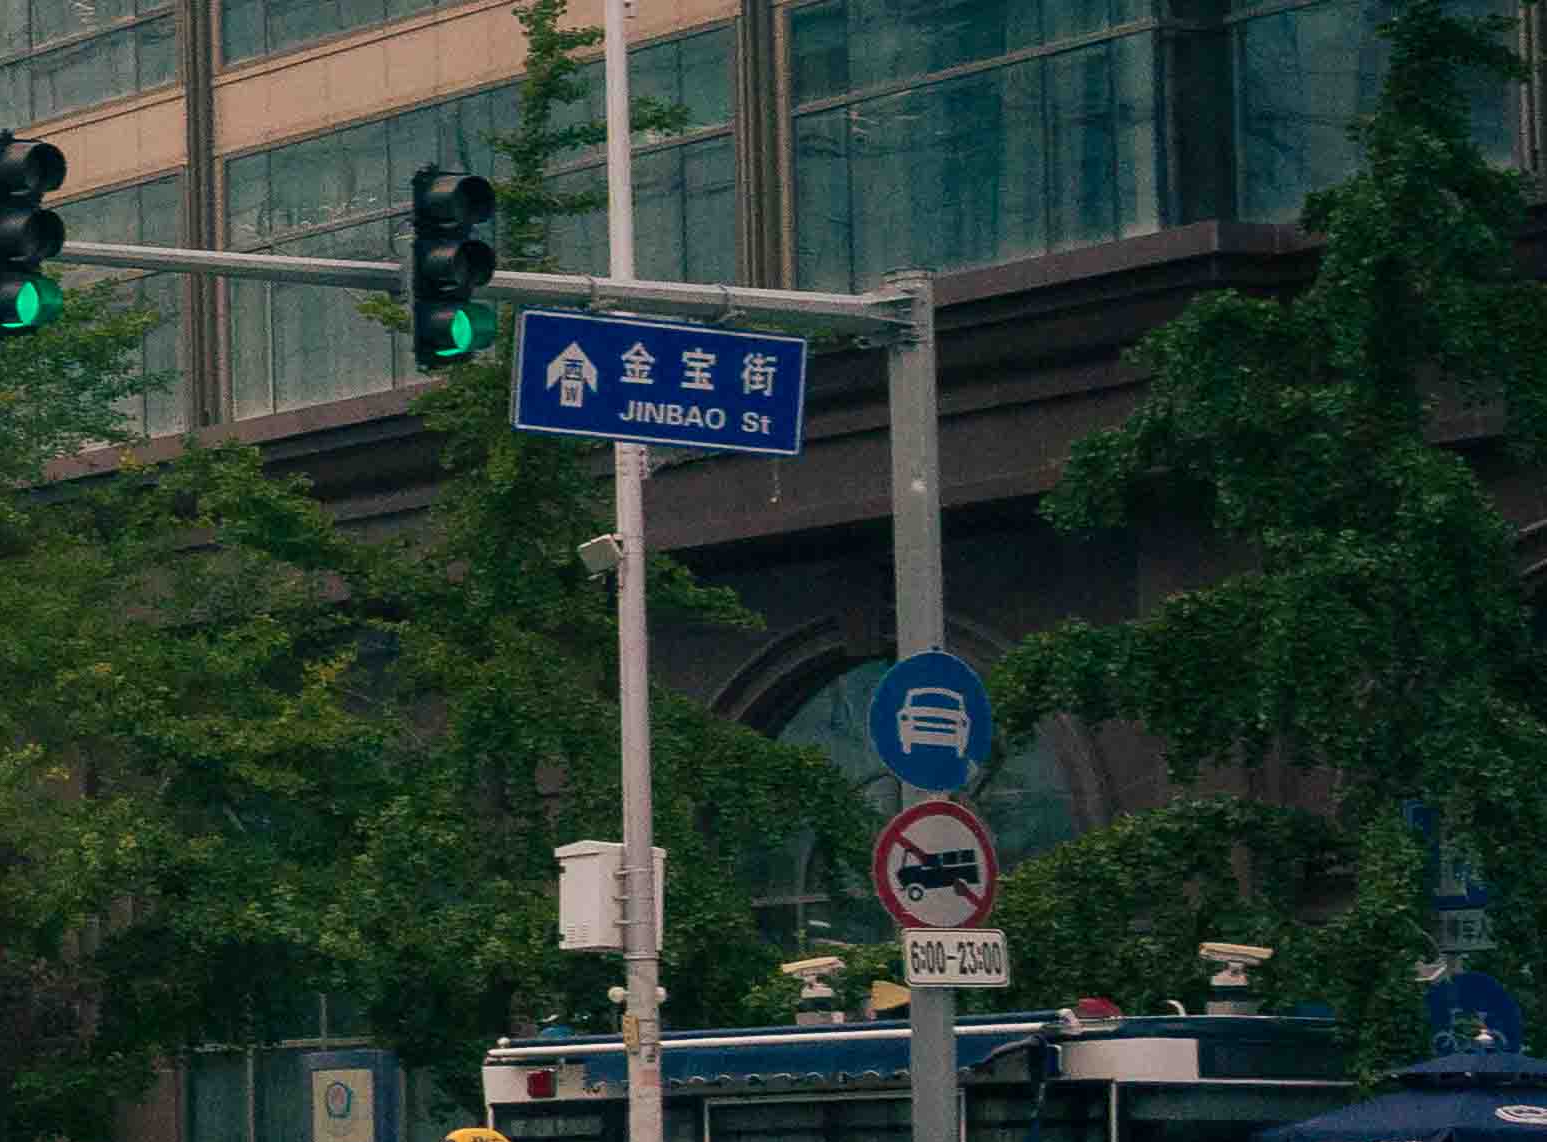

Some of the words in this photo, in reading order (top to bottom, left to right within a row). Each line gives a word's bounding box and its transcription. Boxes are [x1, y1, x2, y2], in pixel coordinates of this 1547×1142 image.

[619, 341, 778, 397] 金宝街
[619, 400, 726, 430] JINBAO
[742, 412, 773, 435] St
[910, 940, 1003, 975] 6:00-23:00
